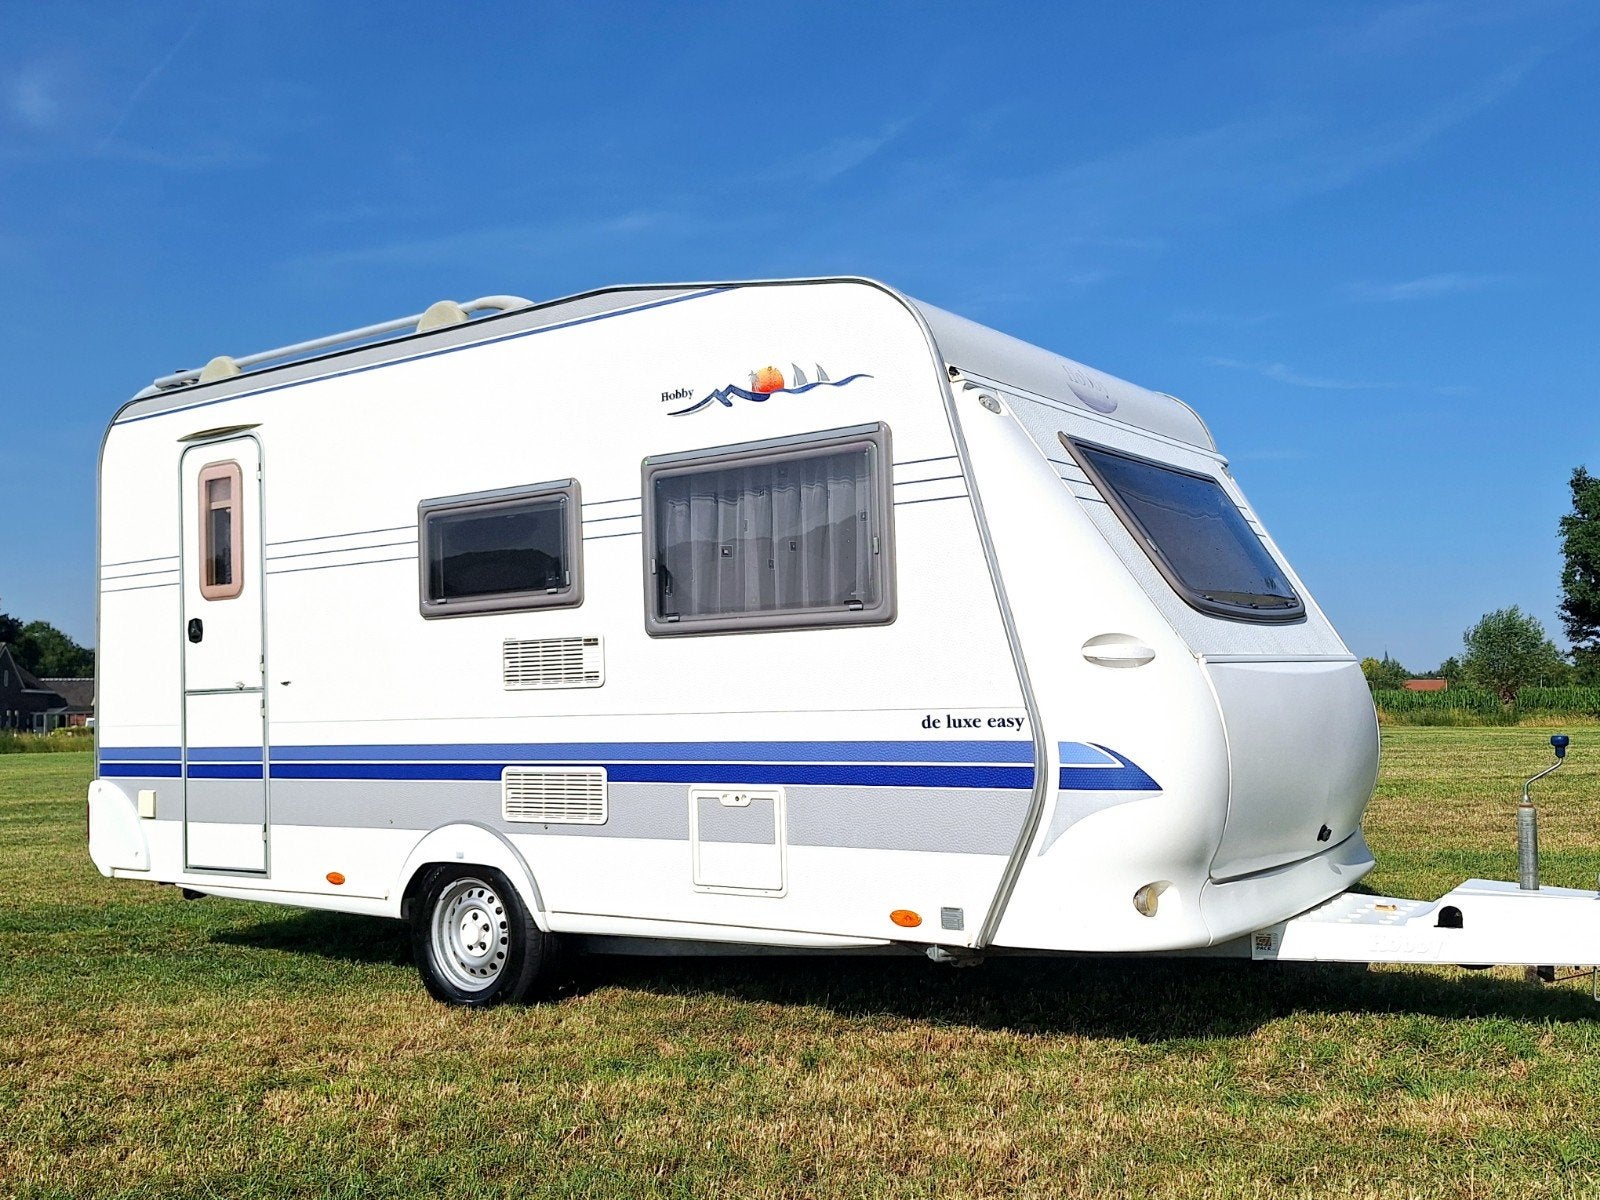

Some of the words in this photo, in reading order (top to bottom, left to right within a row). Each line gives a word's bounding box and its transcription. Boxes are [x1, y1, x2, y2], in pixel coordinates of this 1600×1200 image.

[660, 388, 694, 402] Hobby
[921, 714, 941, 729] de
[946, 714, 981, 729] luxe
[987, 716, 1025, 732] easy
